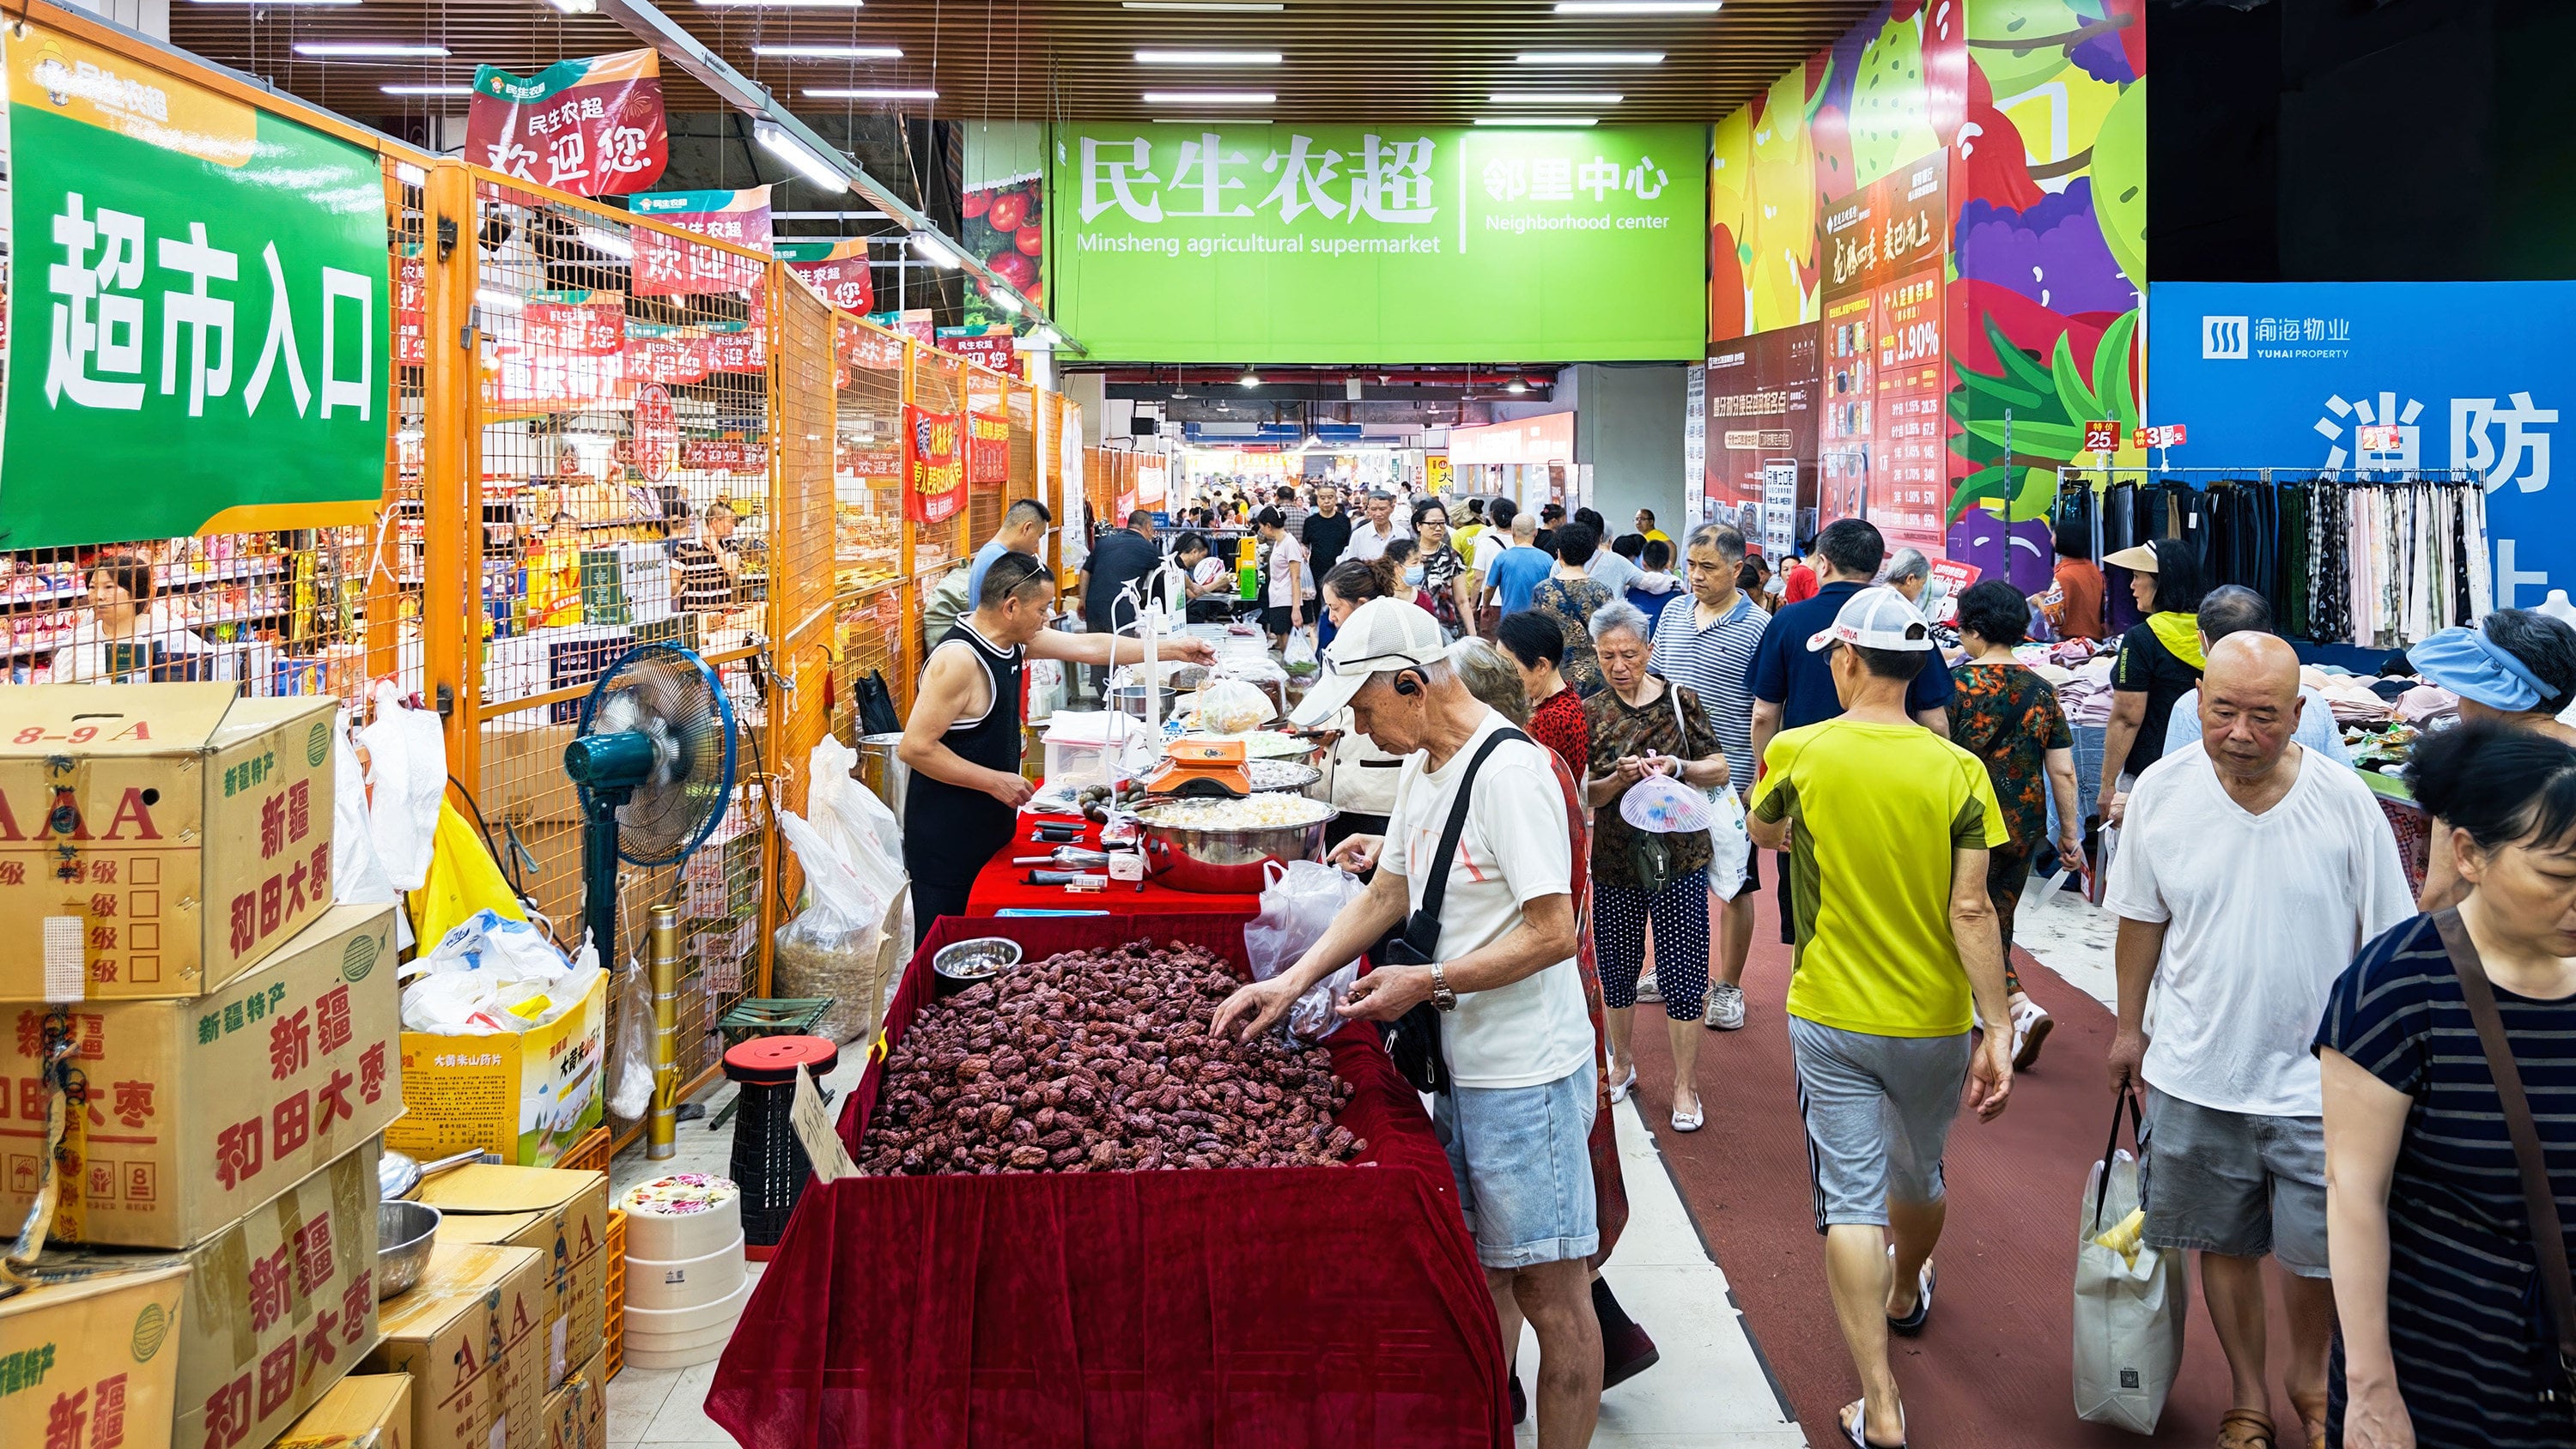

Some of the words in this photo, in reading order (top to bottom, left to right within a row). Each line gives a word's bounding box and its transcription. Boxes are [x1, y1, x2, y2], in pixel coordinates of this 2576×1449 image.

[529, 97, 606, 137] 民生农超
[487, 125, 653, 188] 欢迎您
[1079, 134, 1439, 226] 民生农超
[1483, 155, 1668, 203] 邻里中心
[1078, 233, 1179, 258] Minsheng
[1188, 233, 1303, 257] agricultural
[1310, 234, 1441, 258] supermarket
[1485, 215, 1611, 236] Neighborhood
[1616, 216, 1670, 230] center
[46, 191, 373, 422] 超市入口
[532, 325, 617, 349] 欢迎您
[1897, 320, 1939, 361] 1.90%
[2255, 318, 2351, 342] 渝海物业
[2257, 349, 2293, 359] YUHAI
[2295, 349, 2349, 359] PROPERTY
[2087, 431, 2111, 448] 25
[2093, 422, 2114, 432] 特价
[2314, 391, 2559, 494] 消防
[1923, 491, 1935, 505] 570
[1837, 625, 1858, 642] CHINA
[13, 726, 99, 744] 8-9
[110, 721, 152, 741] A
[224, 751, 275, 798] 新疆特产
[261, 778, 311, 860] 新疆
[229, 841, 330, 961] 和田大枣
[198, 980, 286, 1046] 新疆特产
[270, 984, 353, 1082] 新疆
[434, 1052, 502, 1069] 大黄米山药片
[216, 1040, 386, 1191] 和田大枣
[248, 1211, 335, 1333] 新疆
[204, 1269, 373, 1449] 和田大枣
[46, 1372, 128, 1449] 新疆
